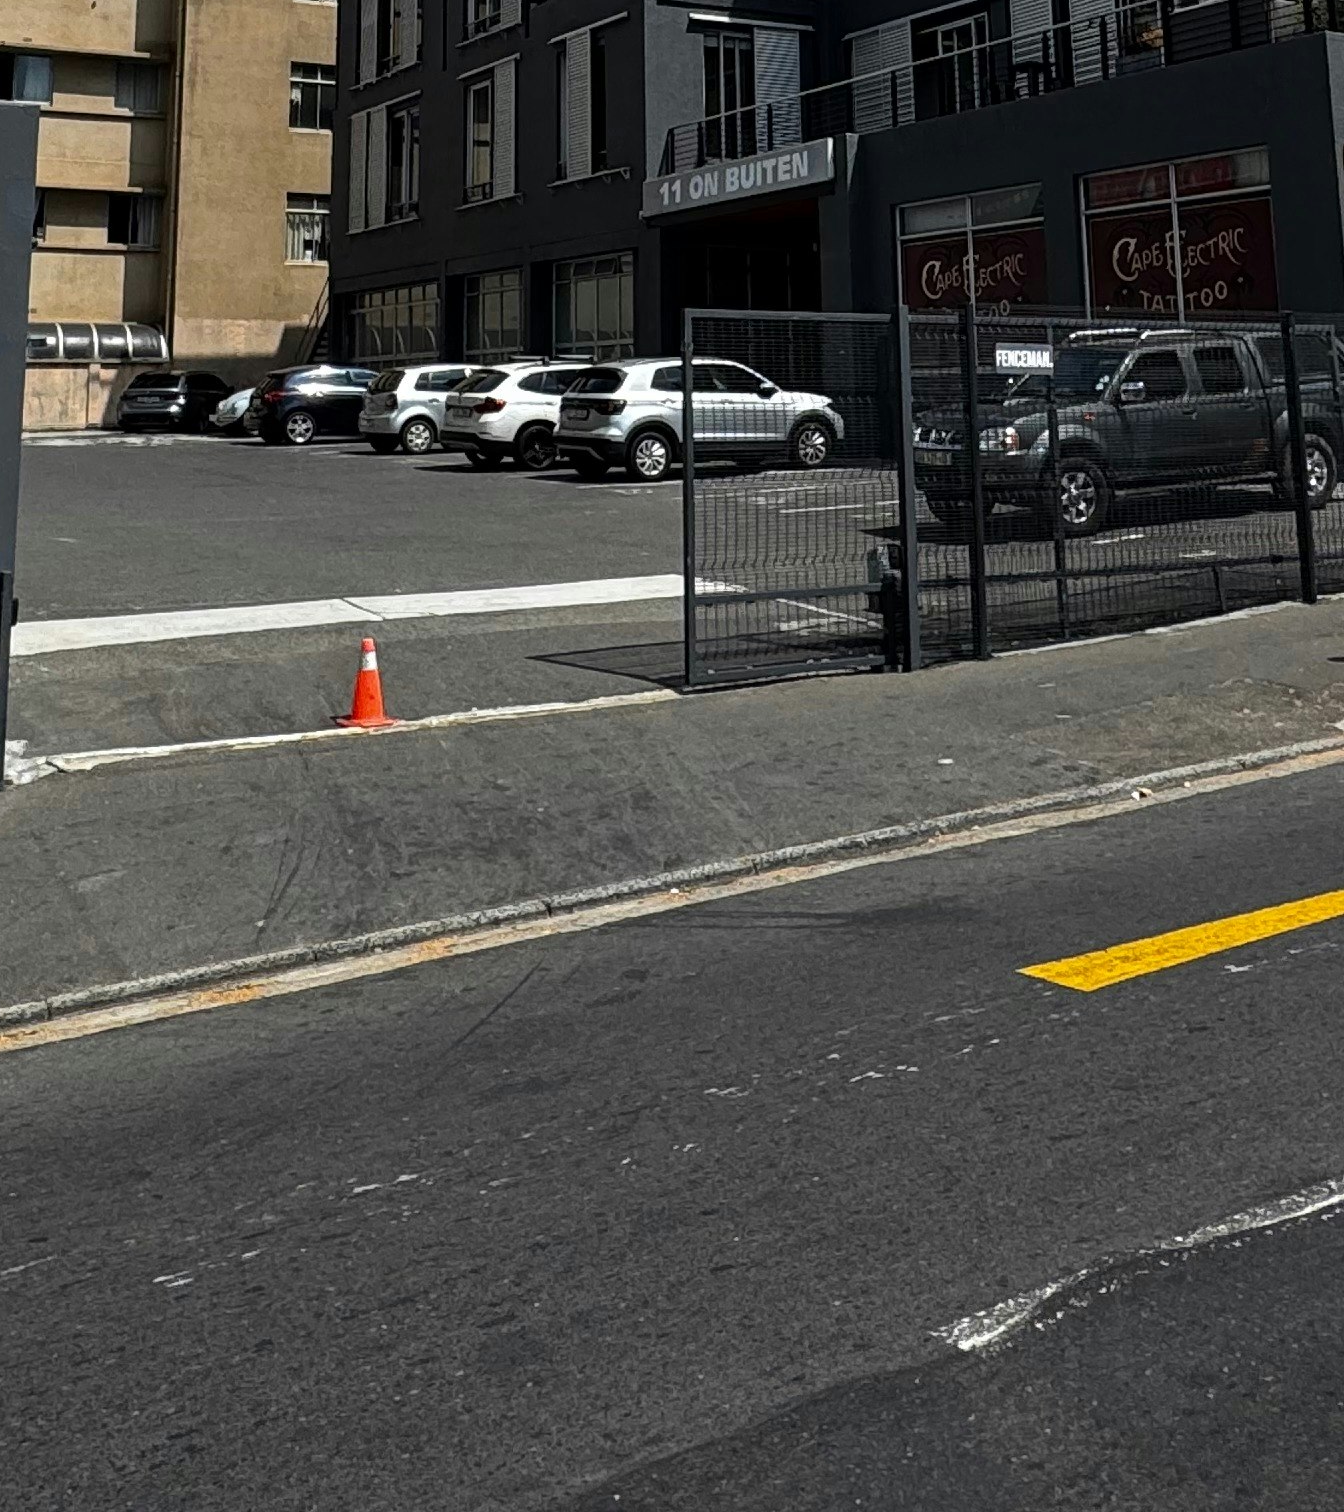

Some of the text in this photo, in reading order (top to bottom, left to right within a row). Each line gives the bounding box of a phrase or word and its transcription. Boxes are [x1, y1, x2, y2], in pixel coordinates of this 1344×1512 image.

[659, 150, 808, 206] 11 ON BUITEN
[1138, 280, 1228, 314] TATTOO
